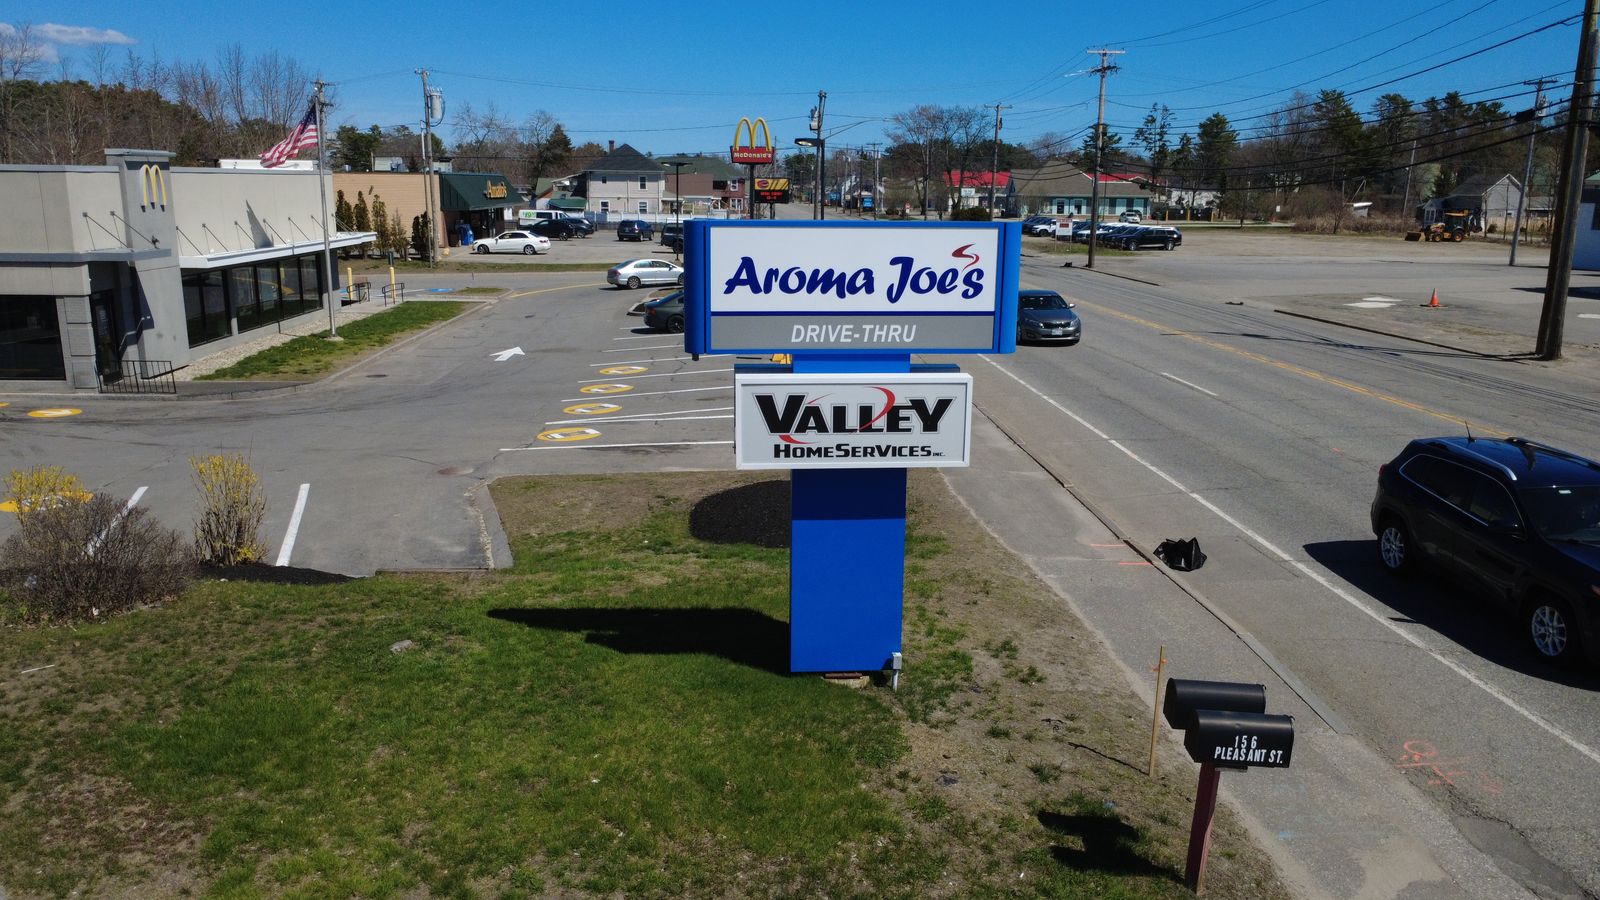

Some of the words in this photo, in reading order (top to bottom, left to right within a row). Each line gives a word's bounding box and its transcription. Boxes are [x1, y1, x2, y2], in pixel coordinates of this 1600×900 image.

[723, 256, 875, 299] Aroma
[886, 253, 985, 304] Joe's
[791, 324, 917, 343] DRIVE-THRU
[753, 394, 956, 435] VALLEY
[1214, 746, 1267, 762] PLEASANT
[1268, 749, 1283, 764] ST.
